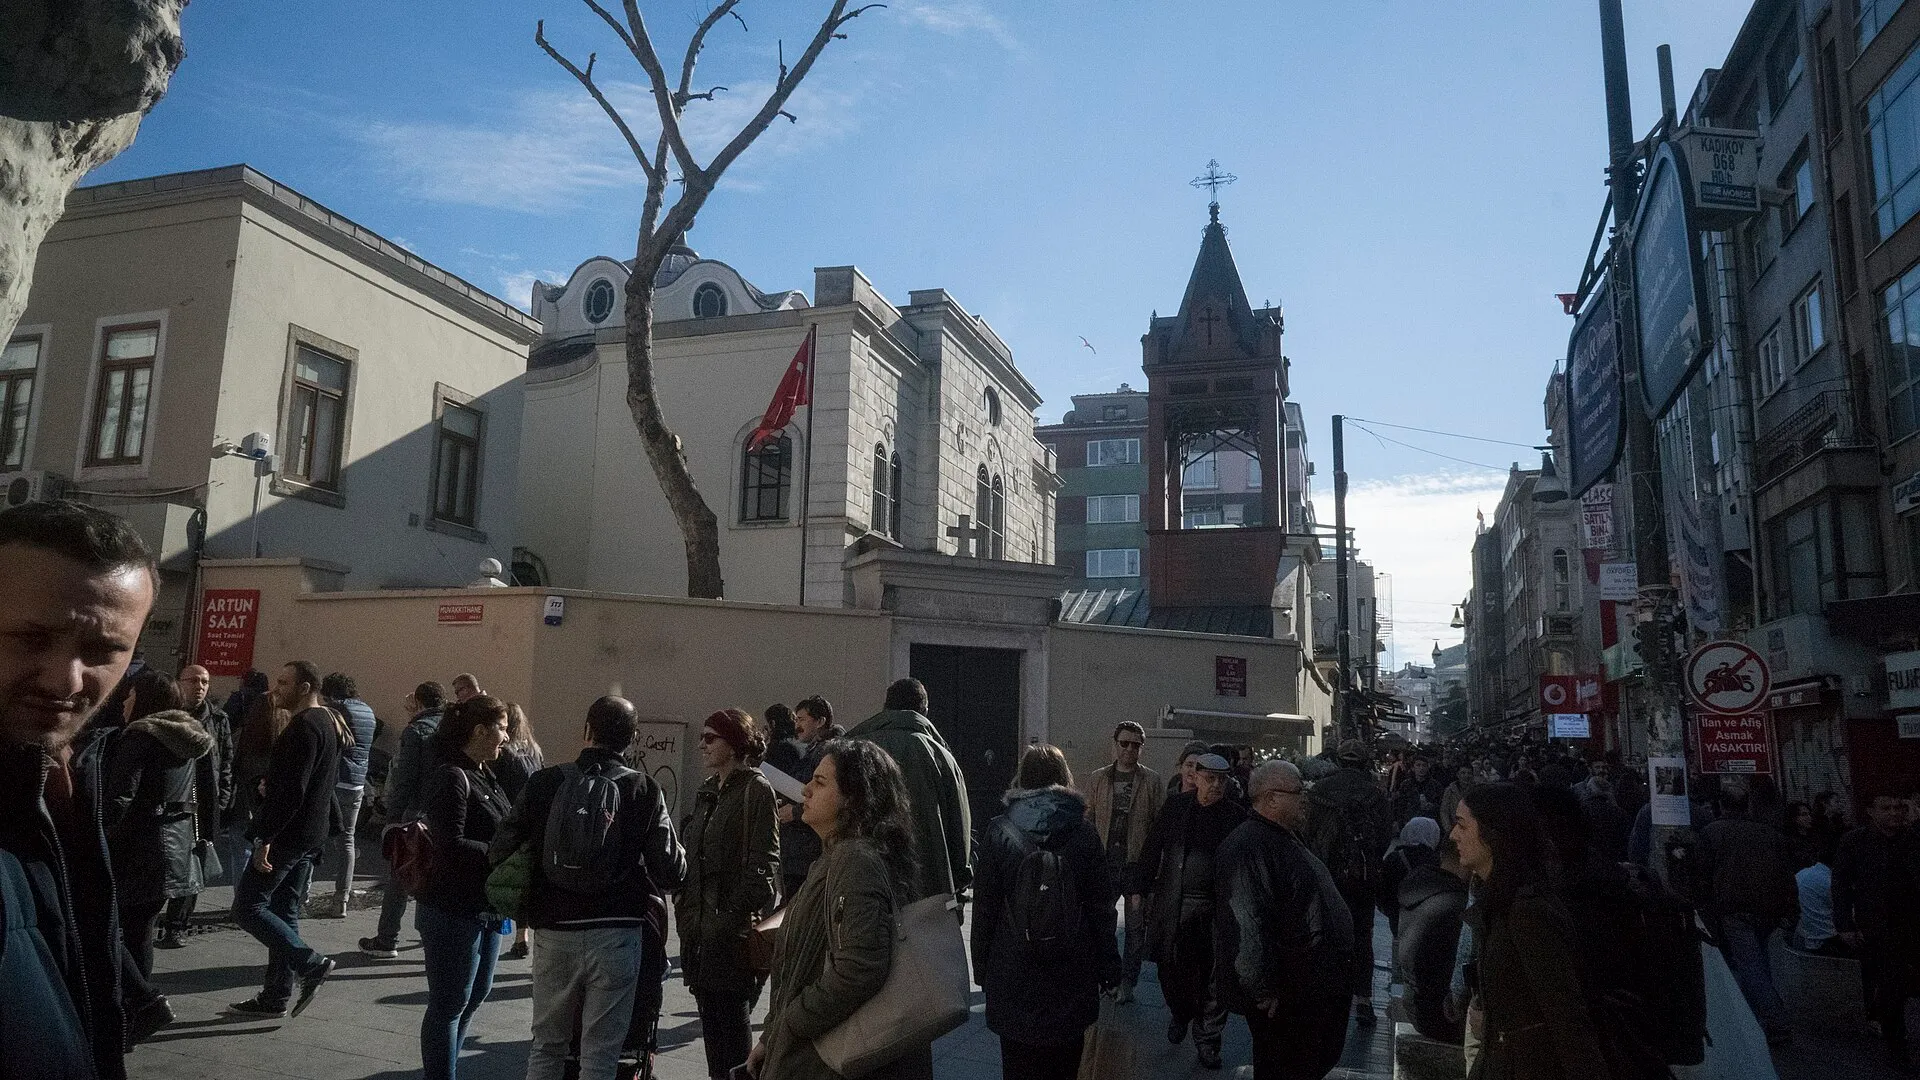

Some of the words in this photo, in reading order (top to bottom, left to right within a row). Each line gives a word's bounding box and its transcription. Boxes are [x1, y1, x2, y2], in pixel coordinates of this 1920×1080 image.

[206, 598, 254, 613] ARTUN
[208, 615, 247, 628] SAAT
[1715, 731, 1753, 740] Asmak
[1706, 743, 1766, 753] YASAKTIR!
